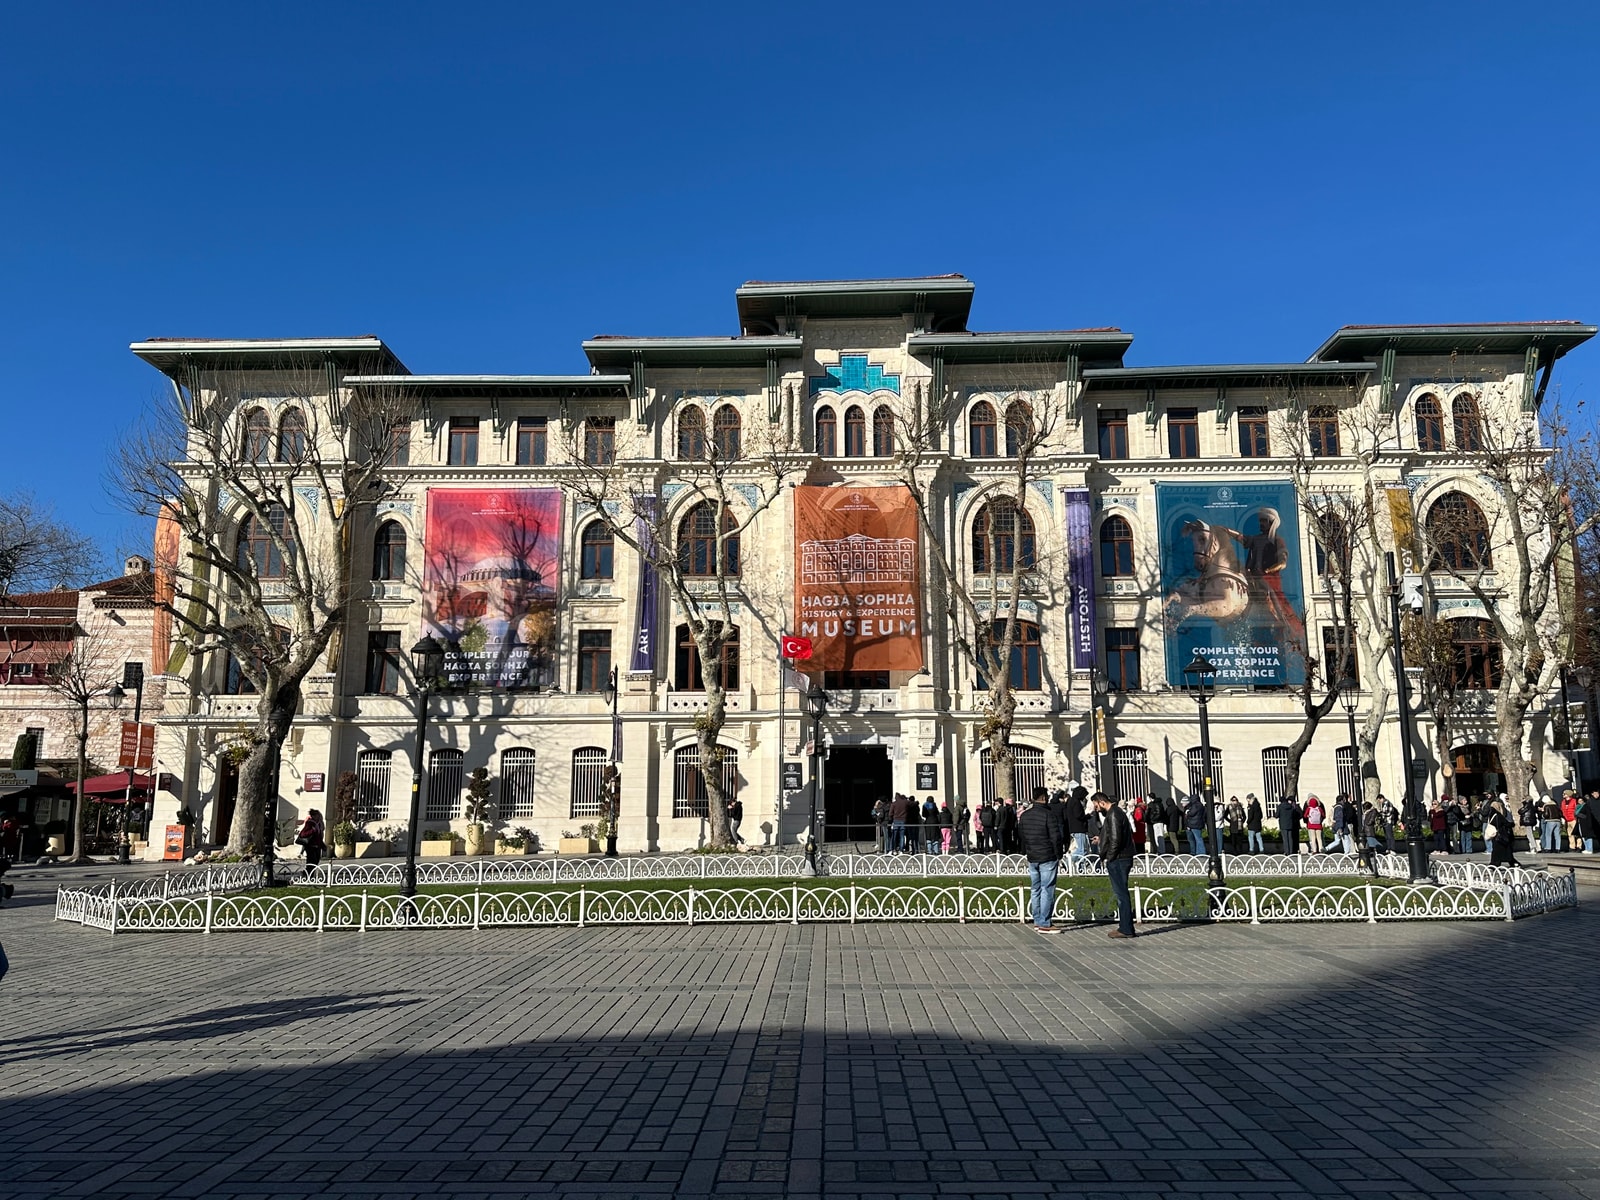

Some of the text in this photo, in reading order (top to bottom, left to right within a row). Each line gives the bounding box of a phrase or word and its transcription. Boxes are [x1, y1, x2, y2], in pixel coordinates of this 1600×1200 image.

[801, 593, 915, 607] HAGIA SOPHIA
[801, 609, 843, 618] HISTORY
[856, 608, 916, 617] EXPERIENCE
[1078, 585, 1091, 652] HISTORY
[801, 619, 916, 637] MUSEUM
[638, 628, 649, 654] ART
[444, 650, 530, 660] COMPLETE YOUR
[1192, 646, 1279, 655] COMPLETE YOUR
[443, 661, 529, 671] HAGIA SOPHIA
[1234, 657, 1281, 666] SOPHIA
[448, 672, 523, 682] EXPERIENCE
